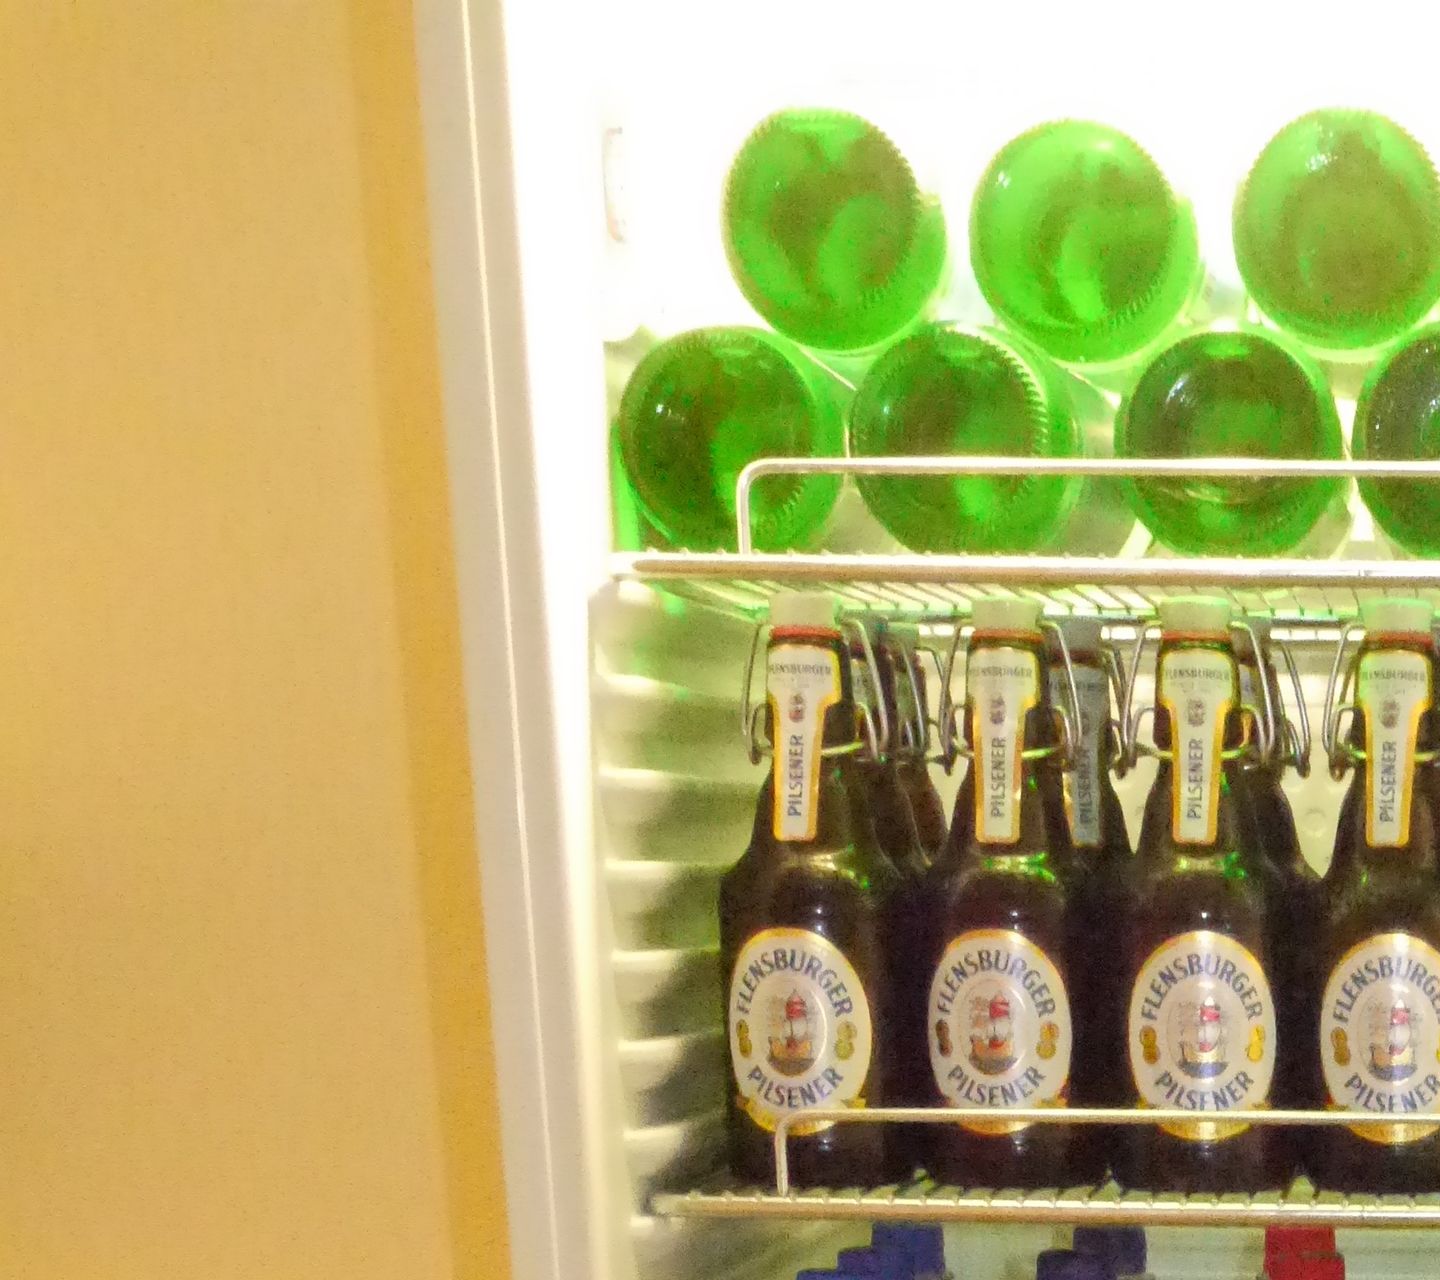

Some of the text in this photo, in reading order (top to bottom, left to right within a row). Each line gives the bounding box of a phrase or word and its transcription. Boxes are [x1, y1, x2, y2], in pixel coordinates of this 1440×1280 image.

[787, 733, 804, 817] PILSENER
[991, 735, 1007, 819] PILSENER
[1186, 737, 1204, 820] PILSENER
[1379, 739, 1397, 823] PILSENER
[735, 948, 855, 1018] FLENSBURGER
[936, 948, 1057, 1018] FLENSBURGER
[1141, 949, 1263, 1024] FLENSBURGER
[747, 1064, 844, 1108] PILSENER
[946, 1064, 1047, 1108] PILSENER
[1154, 1069, 1255, 1112] PILSENER
